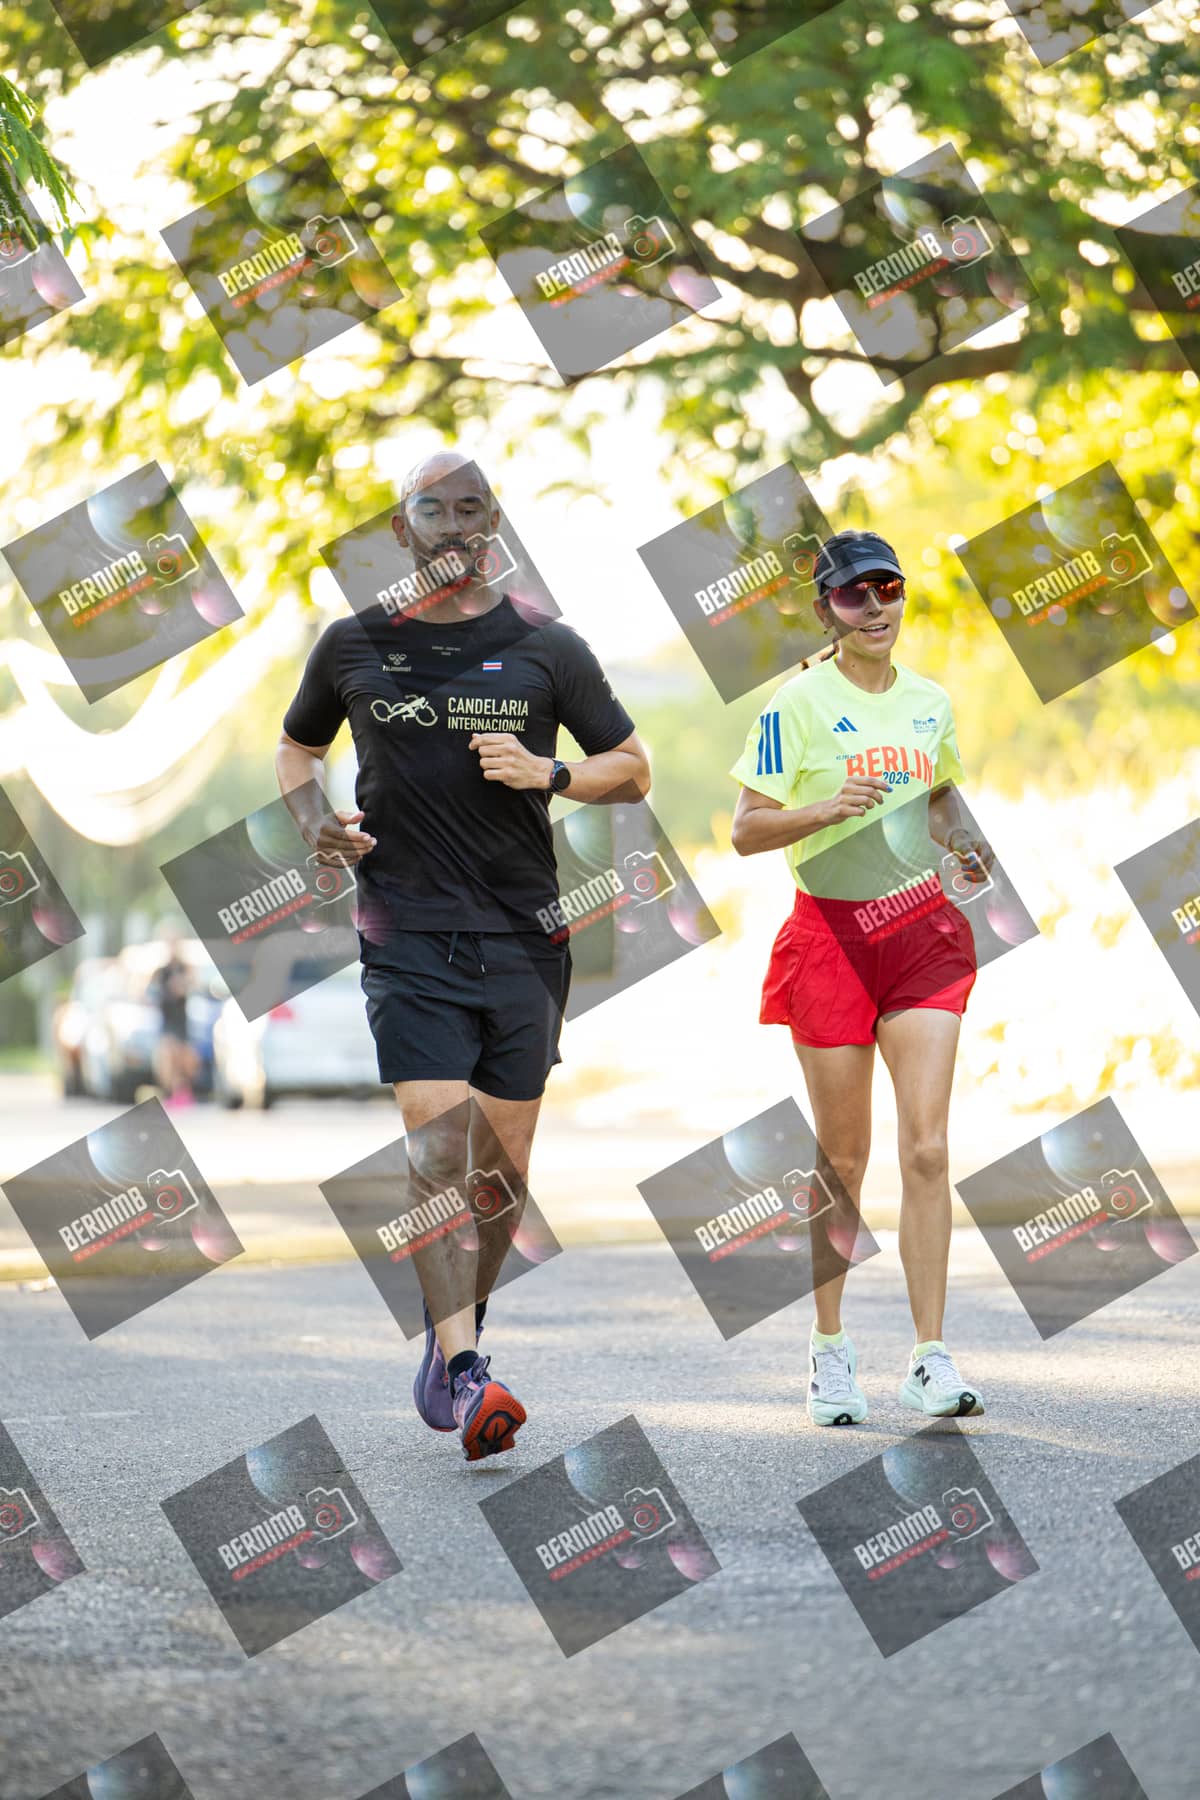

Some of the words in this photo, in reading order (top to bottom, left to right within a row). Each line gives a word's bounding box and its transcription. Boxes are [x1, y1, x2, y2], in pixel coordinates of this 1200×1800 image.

[448, 697, 529, 716] CANDELARIA
[448, 716, 526, 732] INTERNACIONAL
[846, 746, 933, 789] BERLIN
[883, 771, 910, 785] 2026
